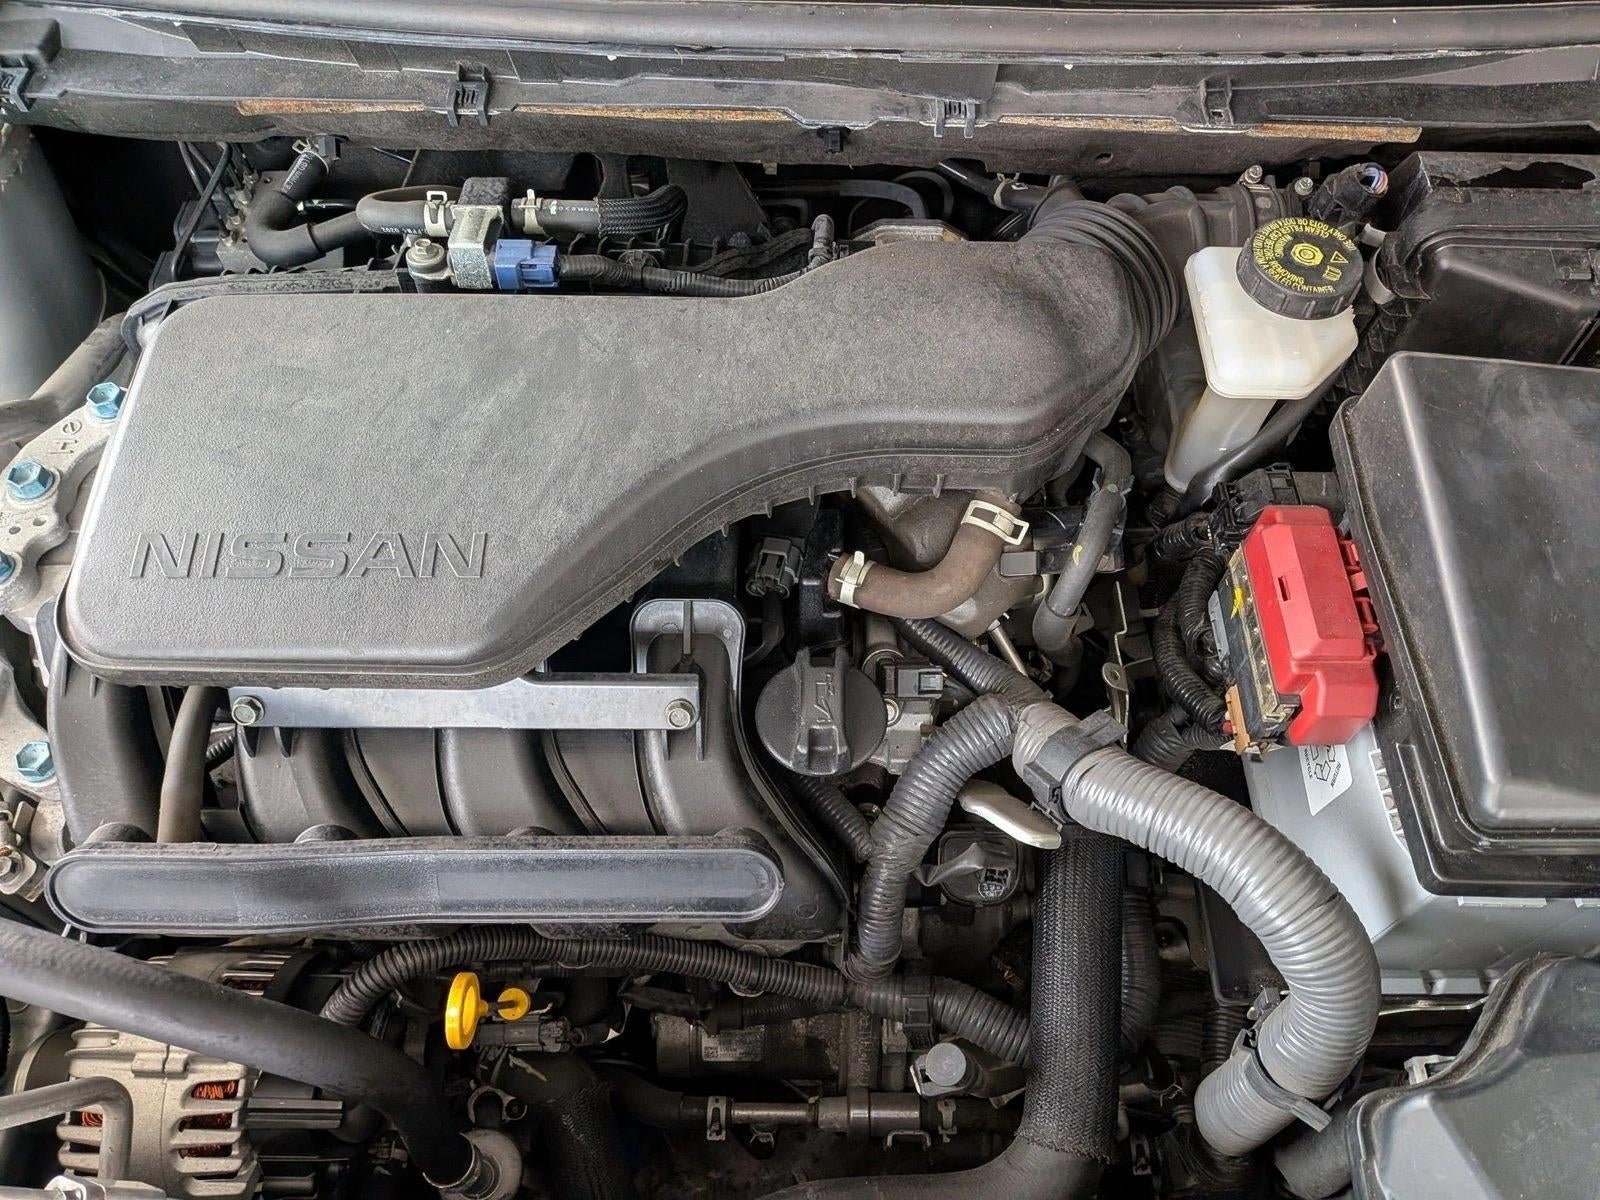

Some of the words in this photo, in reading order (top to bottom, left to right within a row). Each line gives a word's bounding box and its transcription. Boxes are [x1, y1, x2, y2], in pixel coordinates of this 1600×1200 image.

[1297, 217, 1309, 226] OR
[1309, 219, 1329, 231] DOT3
[1304, 225, 1329, 238] CLEAN
[1268, 260, 1305, 284] REMOVING
[129, 531, 489, 579] NISSAN
